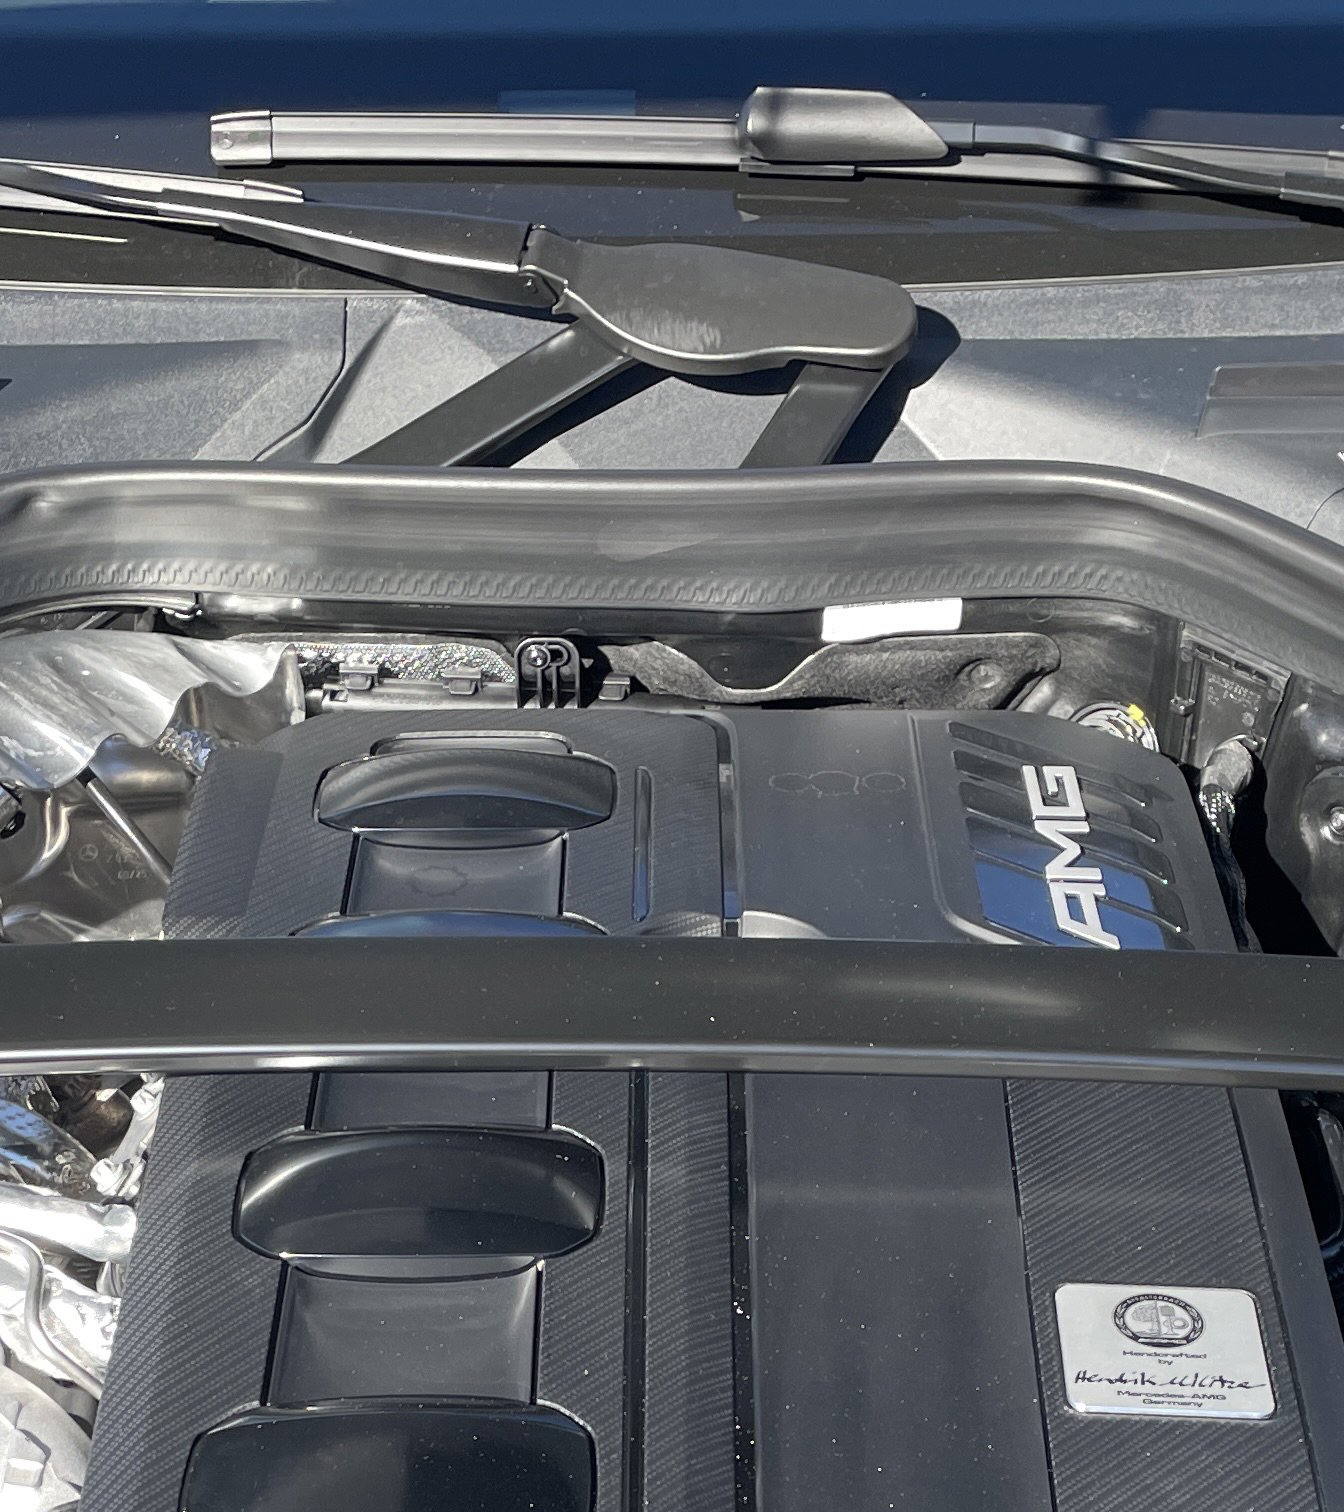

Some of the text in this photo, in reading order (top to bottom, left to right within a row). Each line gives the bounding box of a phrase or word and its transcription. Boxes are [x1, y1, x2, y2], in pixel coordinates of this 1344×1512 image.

[1021, 765, 1120, 950] AMG
[1117, 1390, 1227, 1401] Mercedes-AMG
[1142, 1398, 1203, 1407] Germany
